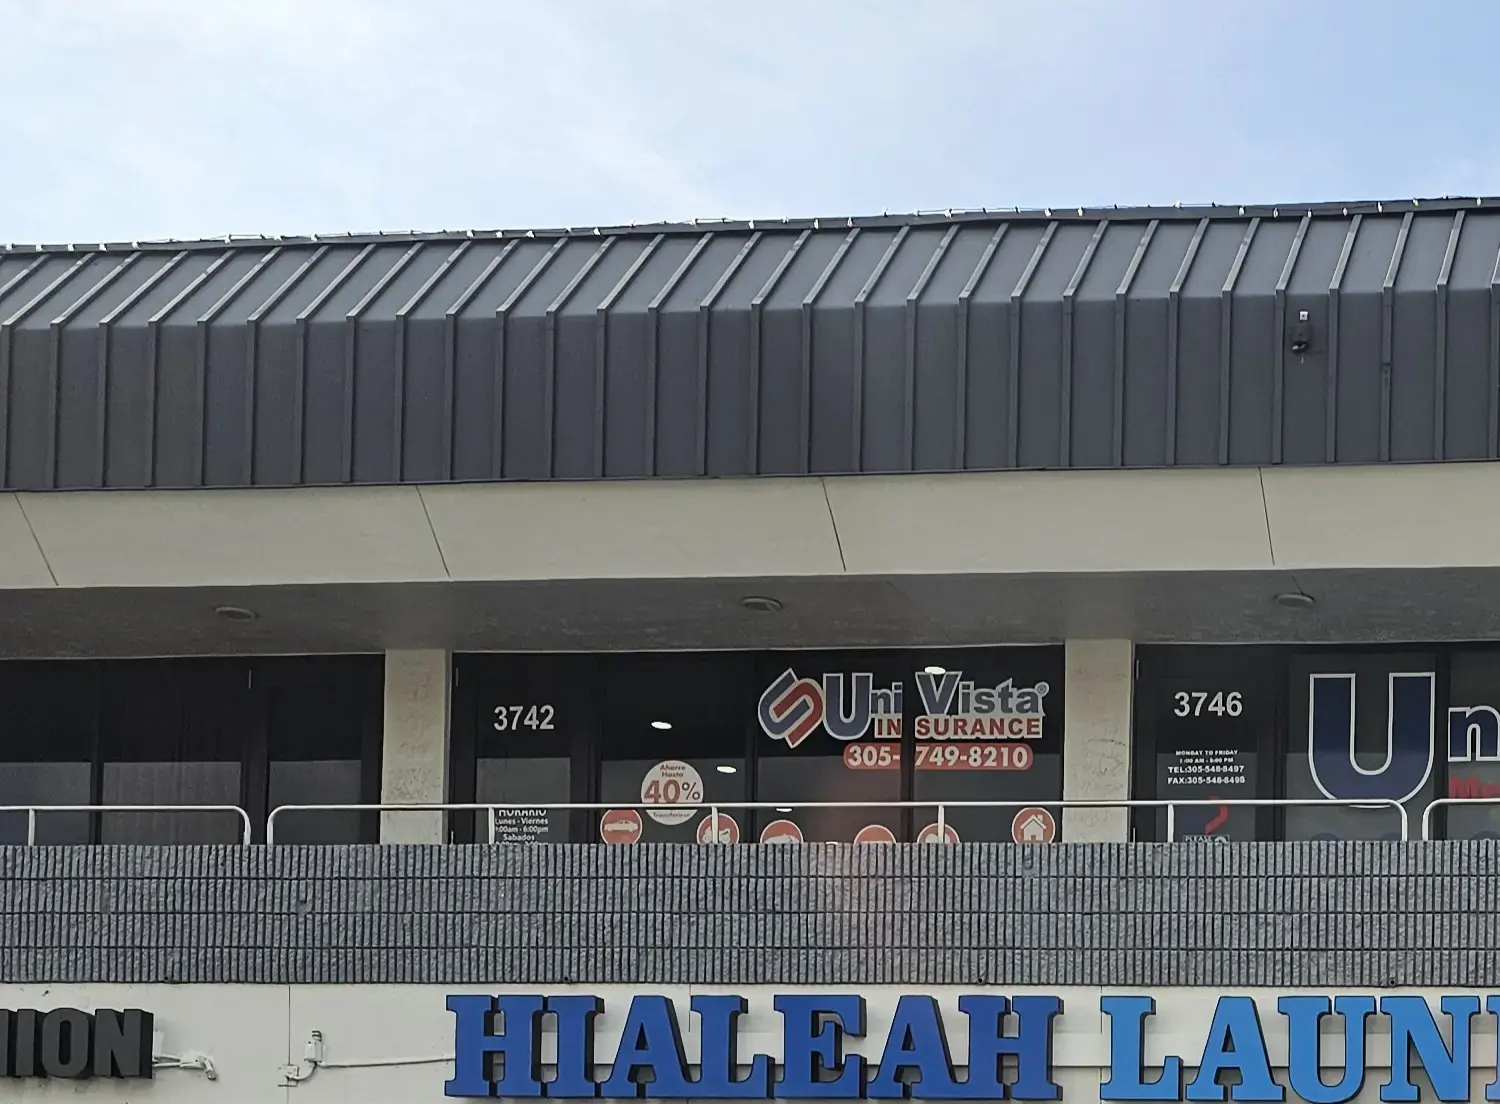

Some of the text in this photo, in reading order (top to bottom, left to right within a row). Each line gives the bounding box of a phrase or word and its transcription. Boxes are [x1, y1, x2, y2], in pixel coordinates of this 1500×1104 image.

[1173, 691, 1243, 717] 3746
[493, 705, 555, 731] 3742
[877, 717, 1042, 737] INSURANCE
[847, 745, 1028, 768] 305-749-8210
[643, 779, 701, 804] 40%
[520, 817, 549, 825] Viernes
[444, 994, 1064, 1100] HIALEAH
